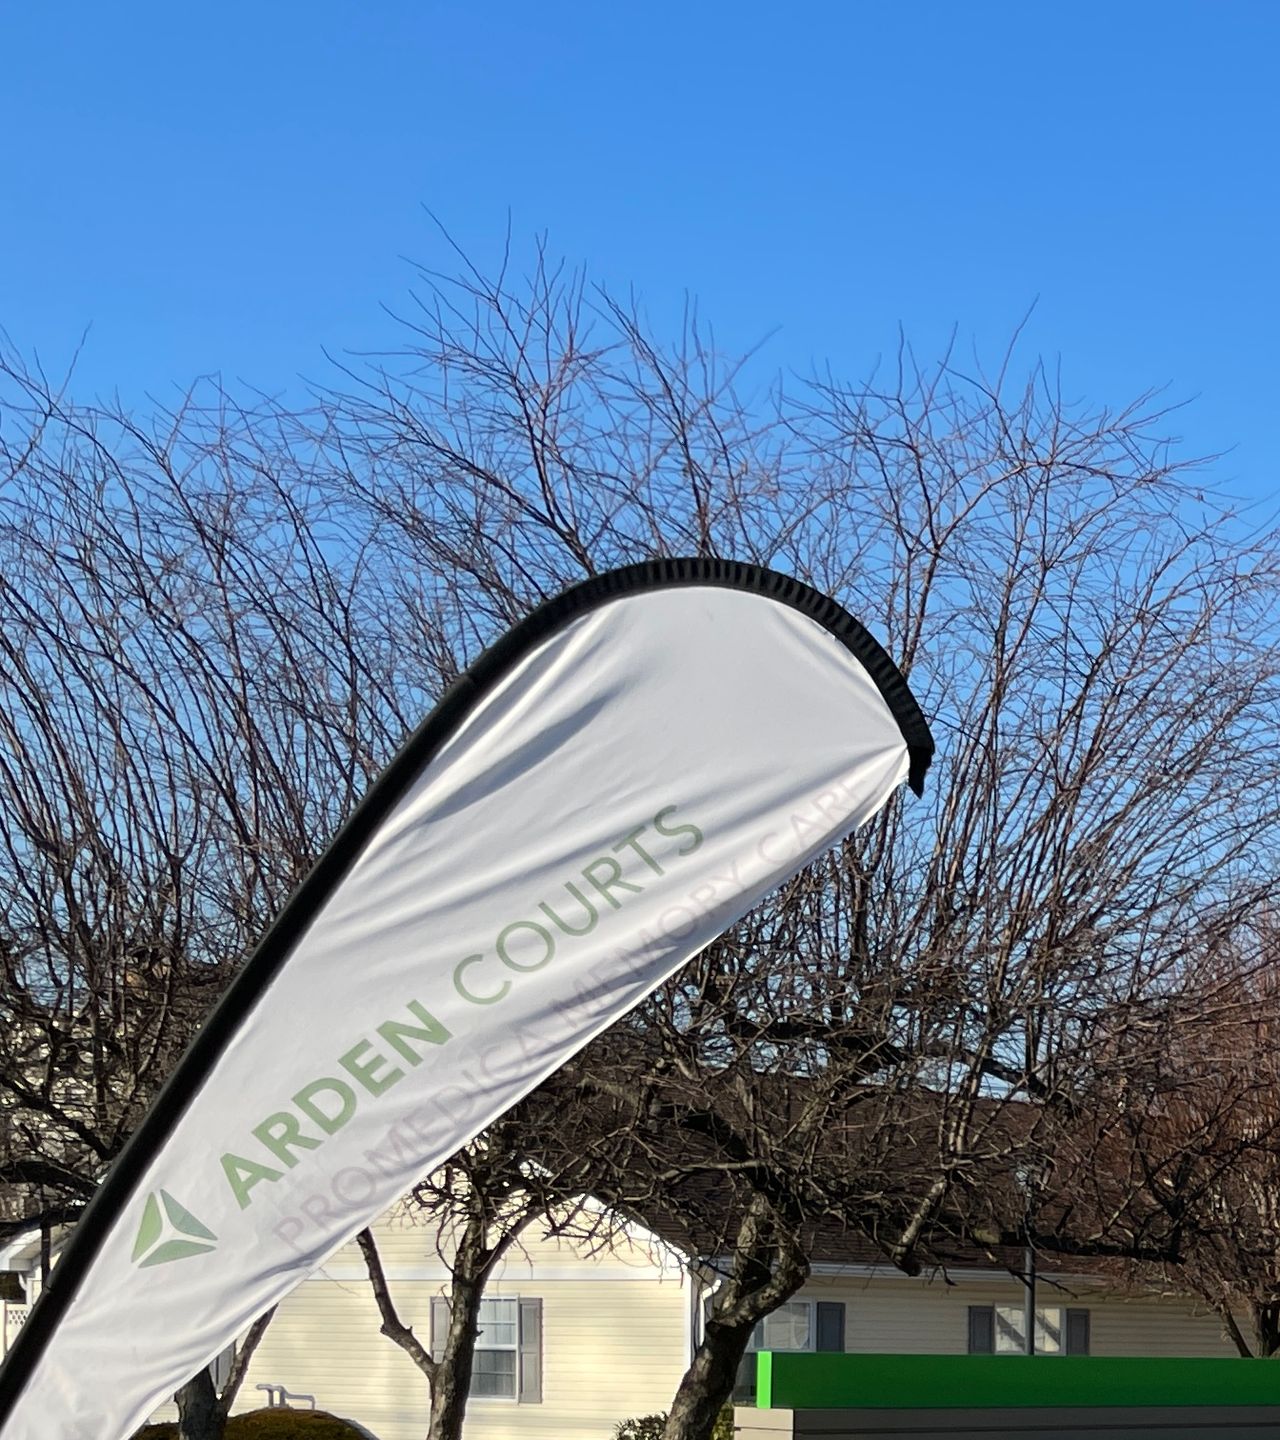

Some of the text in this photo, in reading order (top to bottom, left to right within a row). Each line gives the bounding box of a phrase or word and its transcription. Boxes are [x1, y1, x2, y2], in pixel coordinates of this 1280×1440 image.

[220, 804, 703, 1210] ARDEN COURTS
[272, 1027, 547, 1247] PROMEDICA
